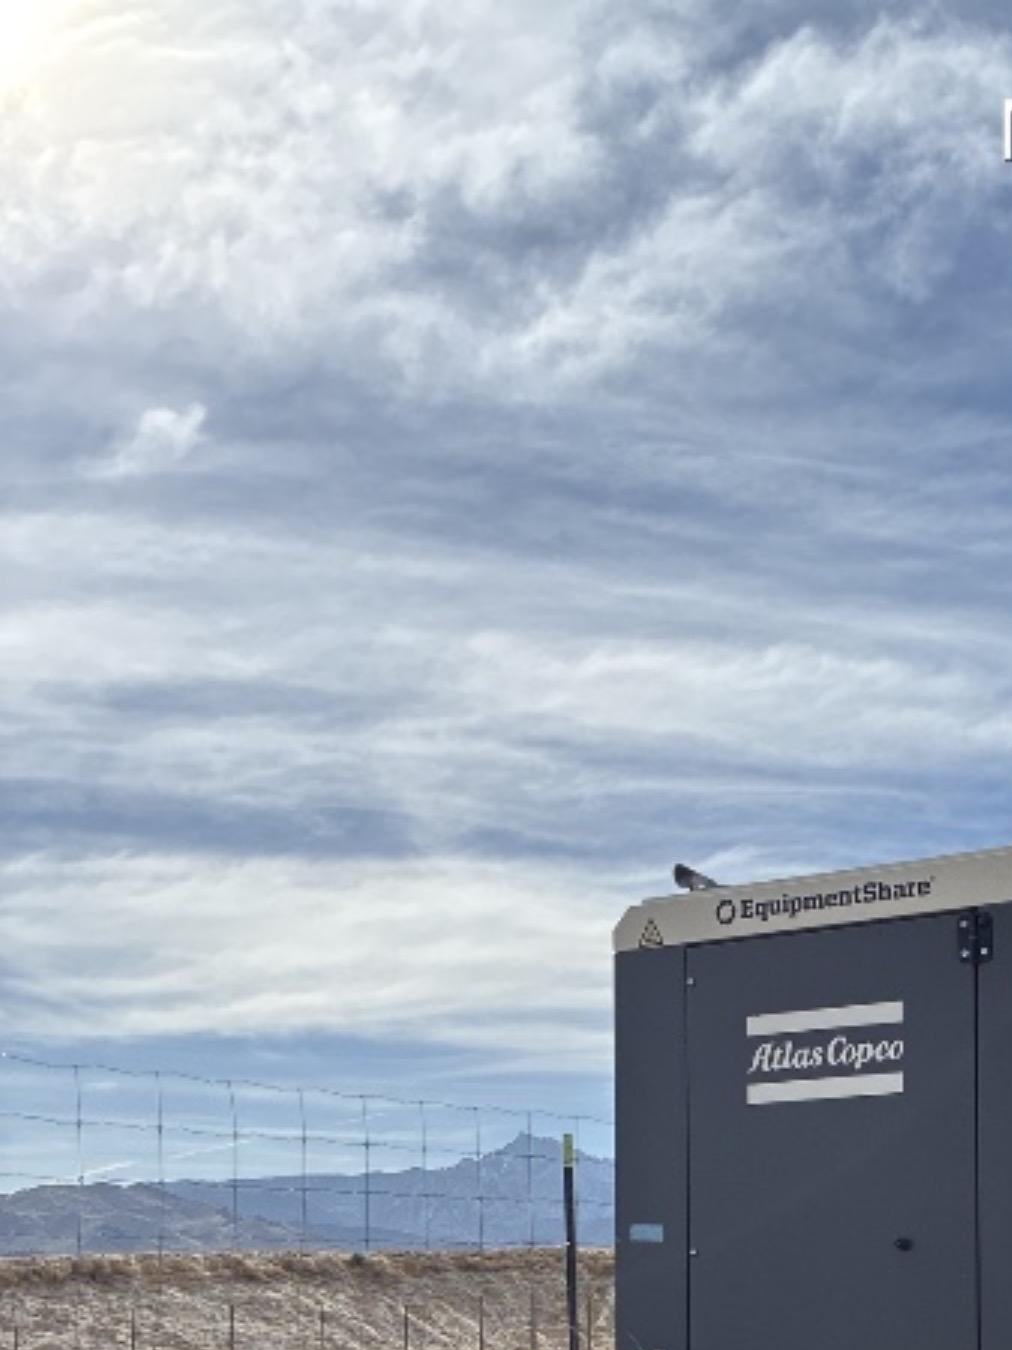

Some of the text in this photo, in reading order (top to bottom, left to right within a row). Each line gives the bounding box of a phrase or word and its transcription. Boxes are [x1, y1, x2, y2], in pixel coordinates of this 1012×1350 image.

[739, 880, 932, 922] EquipmentShare
[747, 1034, 904, 1074] Atlas Copco
